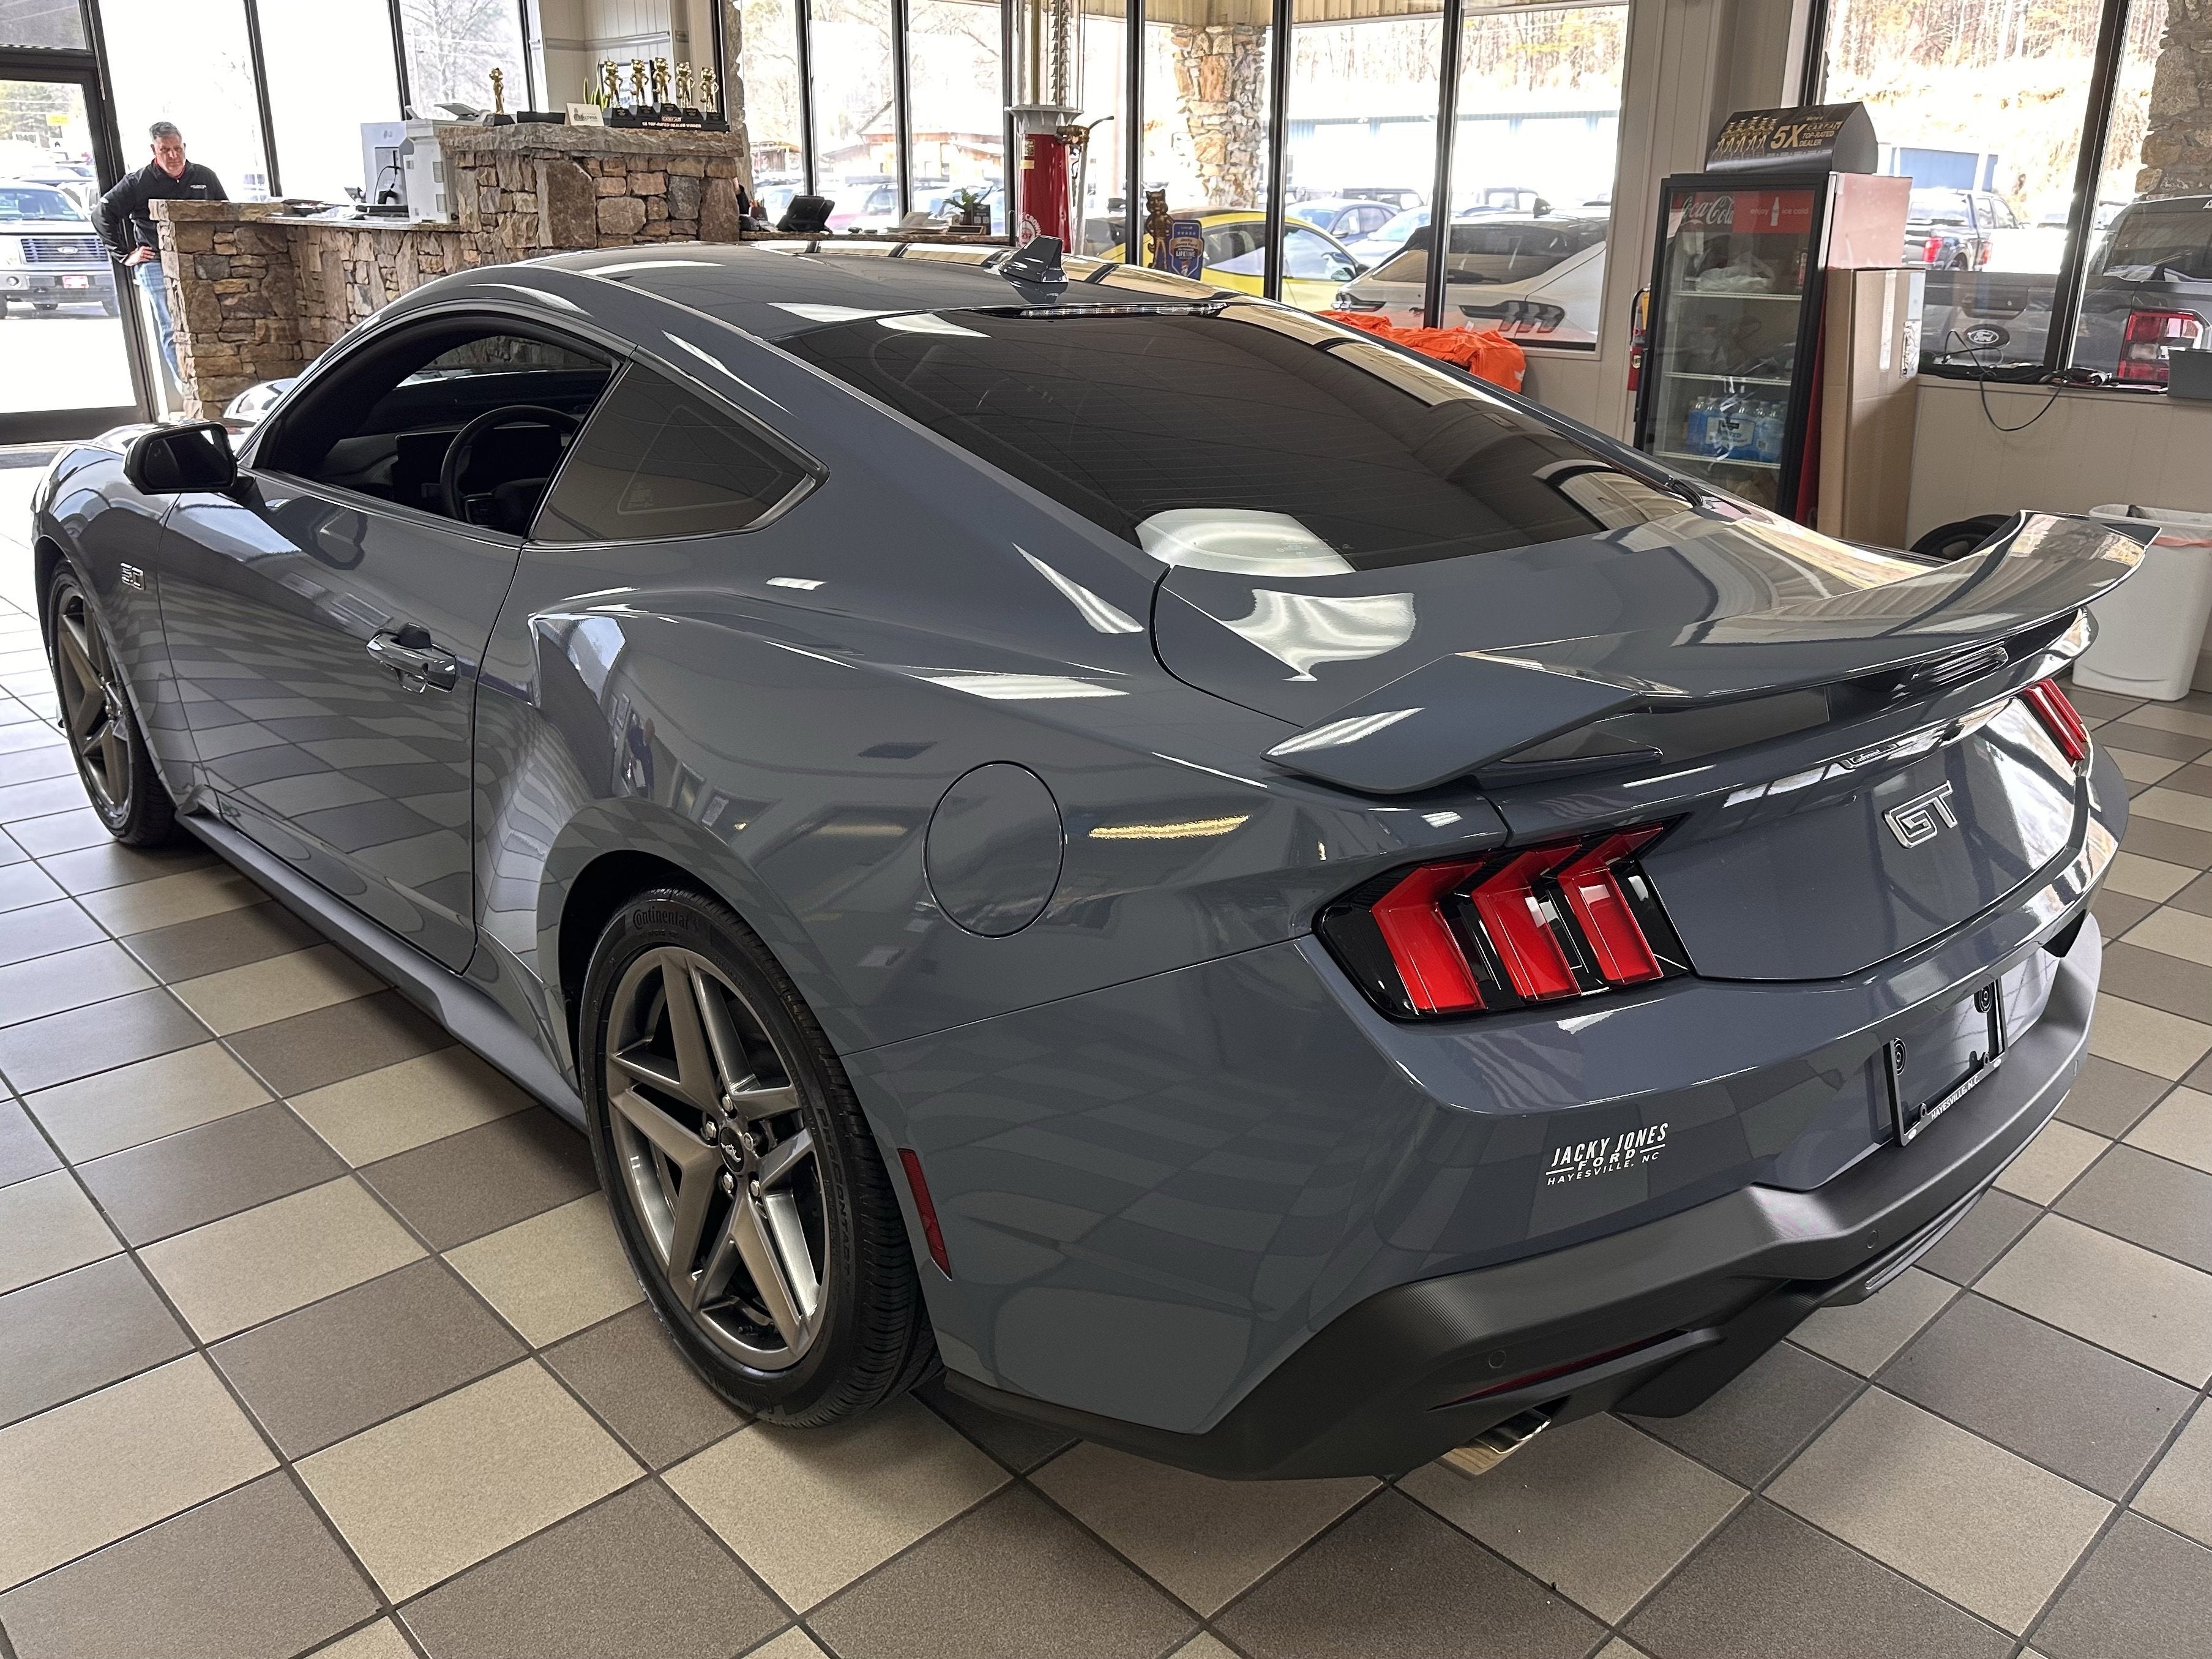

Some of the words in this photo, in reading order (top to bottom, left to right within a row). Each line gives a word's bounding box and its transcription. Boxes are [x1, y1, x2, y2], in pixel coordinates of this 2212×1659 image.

[1770, 124, 1808, 149] 5X
[1798, 138, 1823, 147] DEALER
[1802, 130, 1835, 140] TOP-RATED
[1025, 214, 1042, 236] CROWN
[1883, 780, 1958, 848] GT
[632, 905, 689, 931] Continental
[1551, 1137, 1610, 1167] JACKY
[1615, 1123, 1668, 1153] JONES
[1547, 1159, 1634, 1186] HAYESVILLE,
[1642, 1152, 1659, 1163] NC
[1577, 1148, 1635, 1171] FORD
